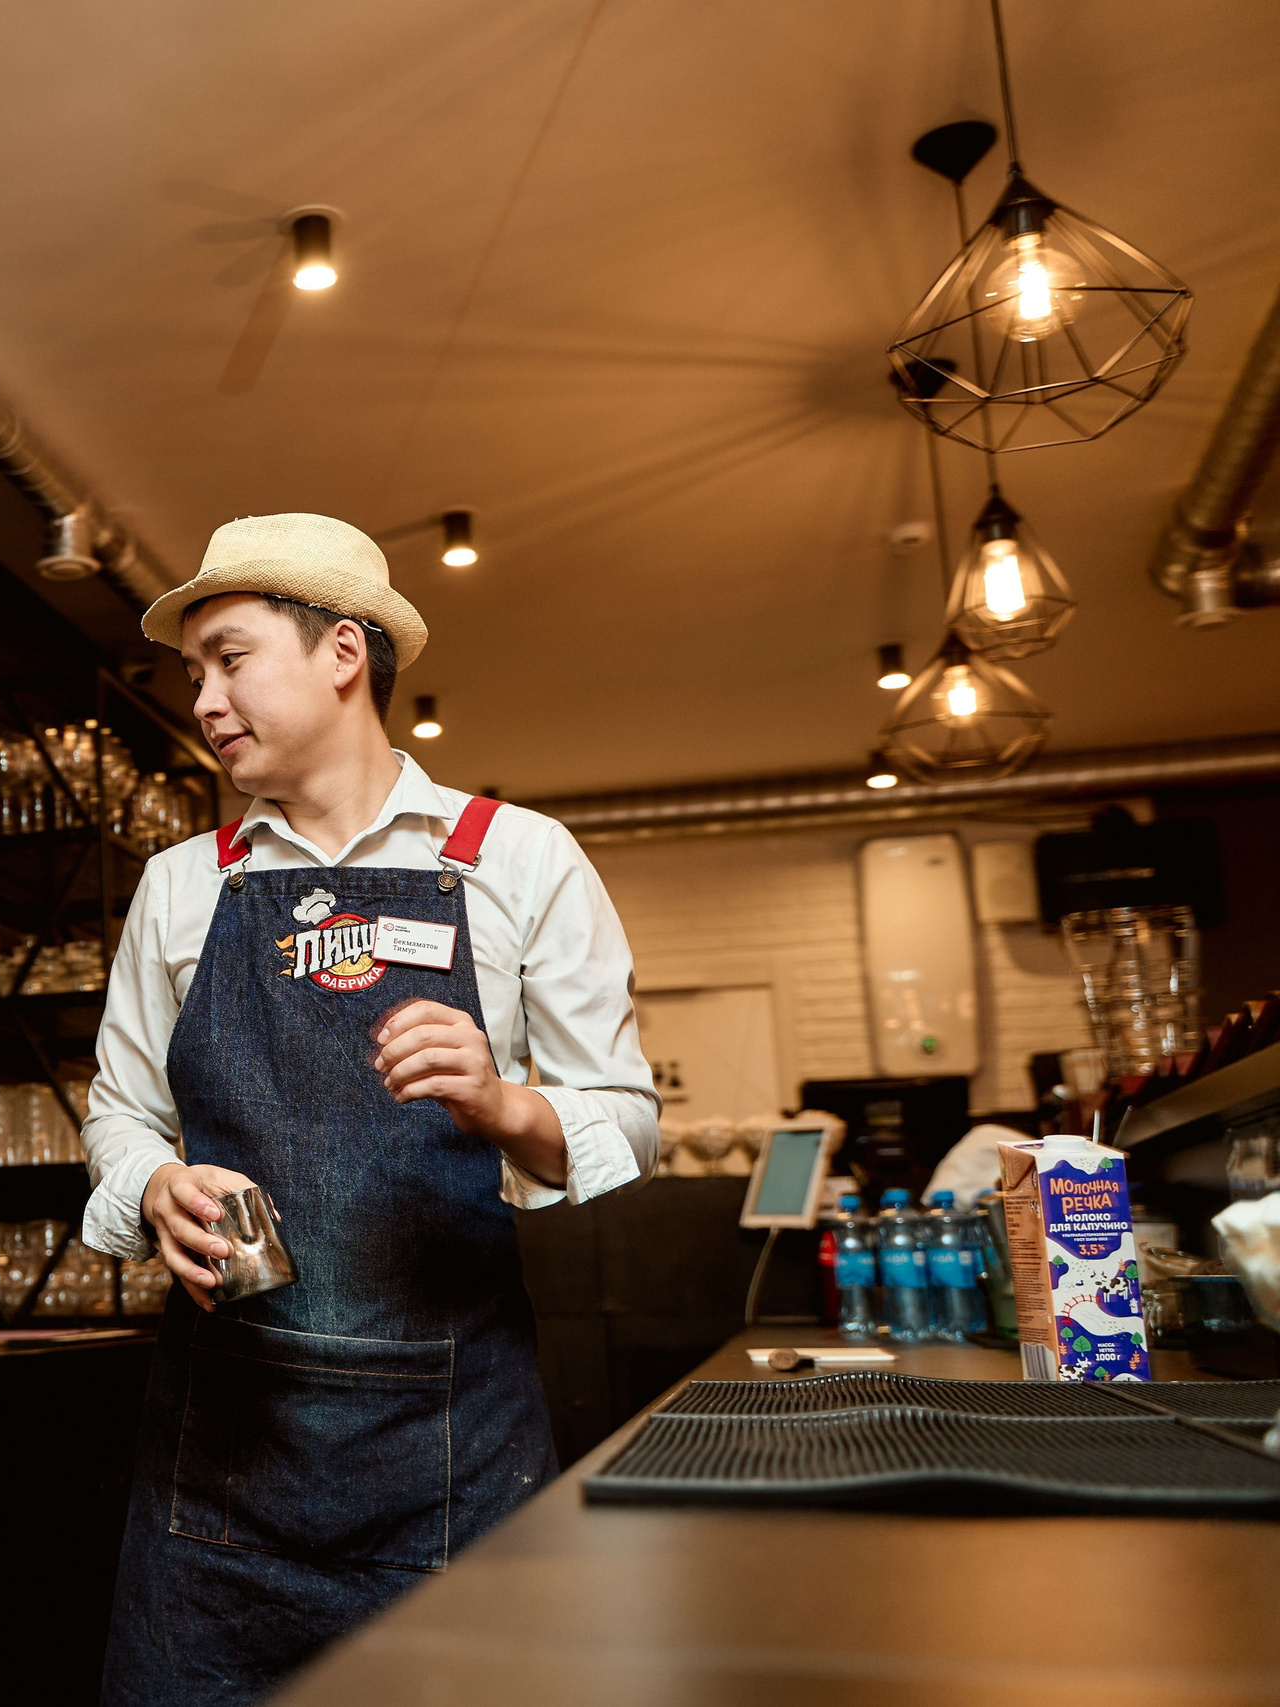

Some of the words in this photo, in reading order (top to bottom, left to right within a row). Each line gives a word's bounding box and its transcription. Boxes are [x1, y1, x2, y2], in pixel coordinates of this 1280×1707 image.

[393, 938, 439, 950] Бекмаматов
[393, 944, 417, 955] Тимур
[293, 922, 378, 980] ПИЦЦ
[320, 966, 384, 989] ФАБРИКА
[1061, 1192, 1113, 1215] РЕЧКА
[1064, 1213, 1111, 1222] МОЛОКО
[1049, 1223, 1071, 1233] ДЛЯ
[1073, 1221, 1128, 1231] КАПУЧИНО
[1079, 1244, 1106, 1256] 3,5%
[1095, 1353, 1116, 1362] 1000
